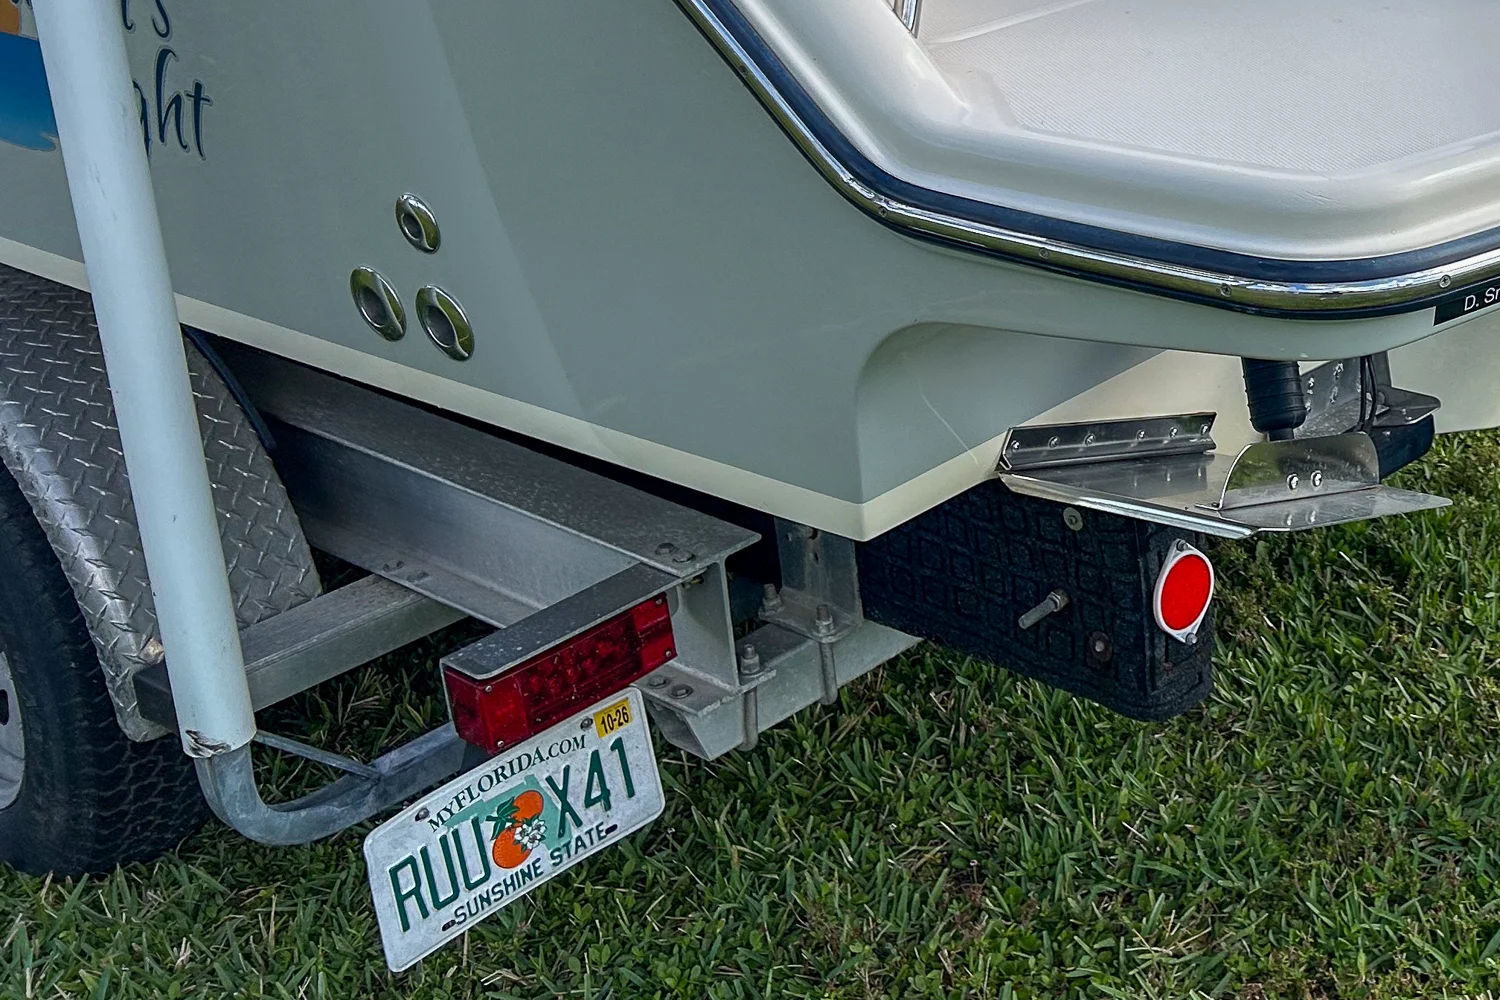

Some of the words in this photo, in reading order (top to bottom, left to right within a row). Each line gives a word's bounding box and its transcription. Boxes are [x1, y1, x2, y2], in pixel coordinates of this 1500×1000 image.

[1464, 294, 1479, 311] D.
[600, 706, 629, 734] 10-26
[428, 734, 586, 833] MYFLORIDA.COM
[389, 816, 491, 932] RUU
[545, 736, 635, 839] X41
[454, 856, 543, 926] SUNSHINE
[550, 821, 607, 868] STATE
